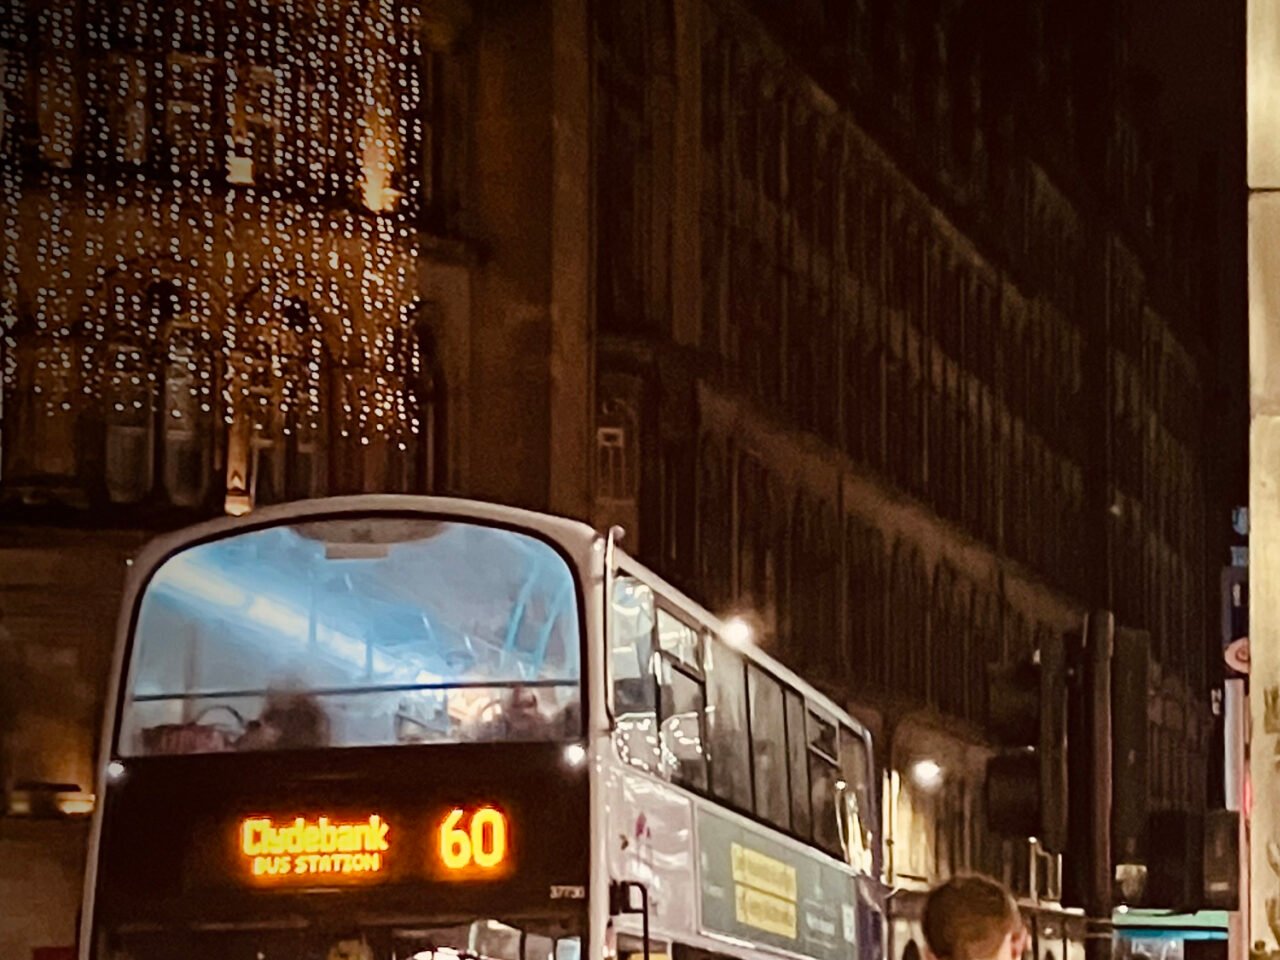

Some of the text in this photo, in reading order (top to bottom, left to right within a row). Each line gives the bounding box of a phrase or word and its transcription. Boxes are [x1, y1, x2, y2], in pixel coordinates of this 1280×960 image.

[243, 815, 390, 854] Clydebank
[440, 808, 506, 869] 60
[253, 855, 291, 875] BUS
